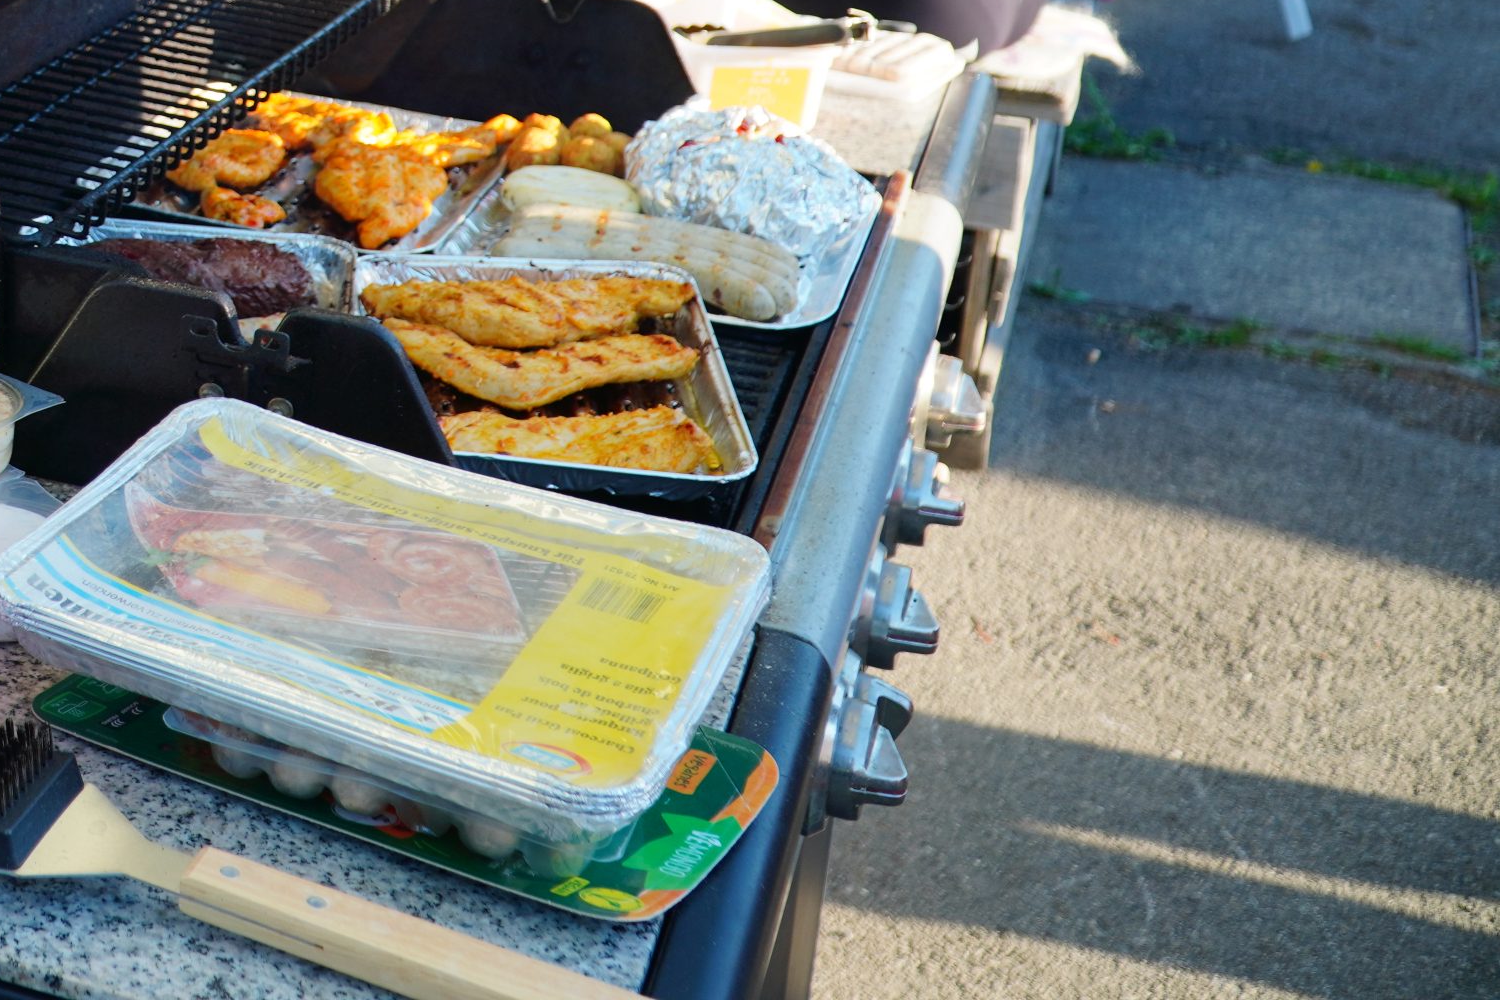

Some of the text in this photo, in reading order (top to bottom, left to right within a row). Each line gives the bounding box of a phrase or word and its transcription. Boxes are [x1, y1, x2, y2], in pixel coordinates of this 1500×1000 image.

[243, 459, 322, 489] Holzkohle
[353, 495, 409, 516] Grillen
[552, 551, 586, 567] Für
[641, 575, 660, 587] No.
[560, 662, 611, 684] griglia
[538, 674, 661, 716] charbon de bois
[624, 682, 671, 701] Tglia
[520, 695, 561, 712] pour
[494, 703, 636, 754] Charcoal Grill Pan
[673, 754, 708, 788] veganes
[659, 830, 722, 879] VEMONDO
